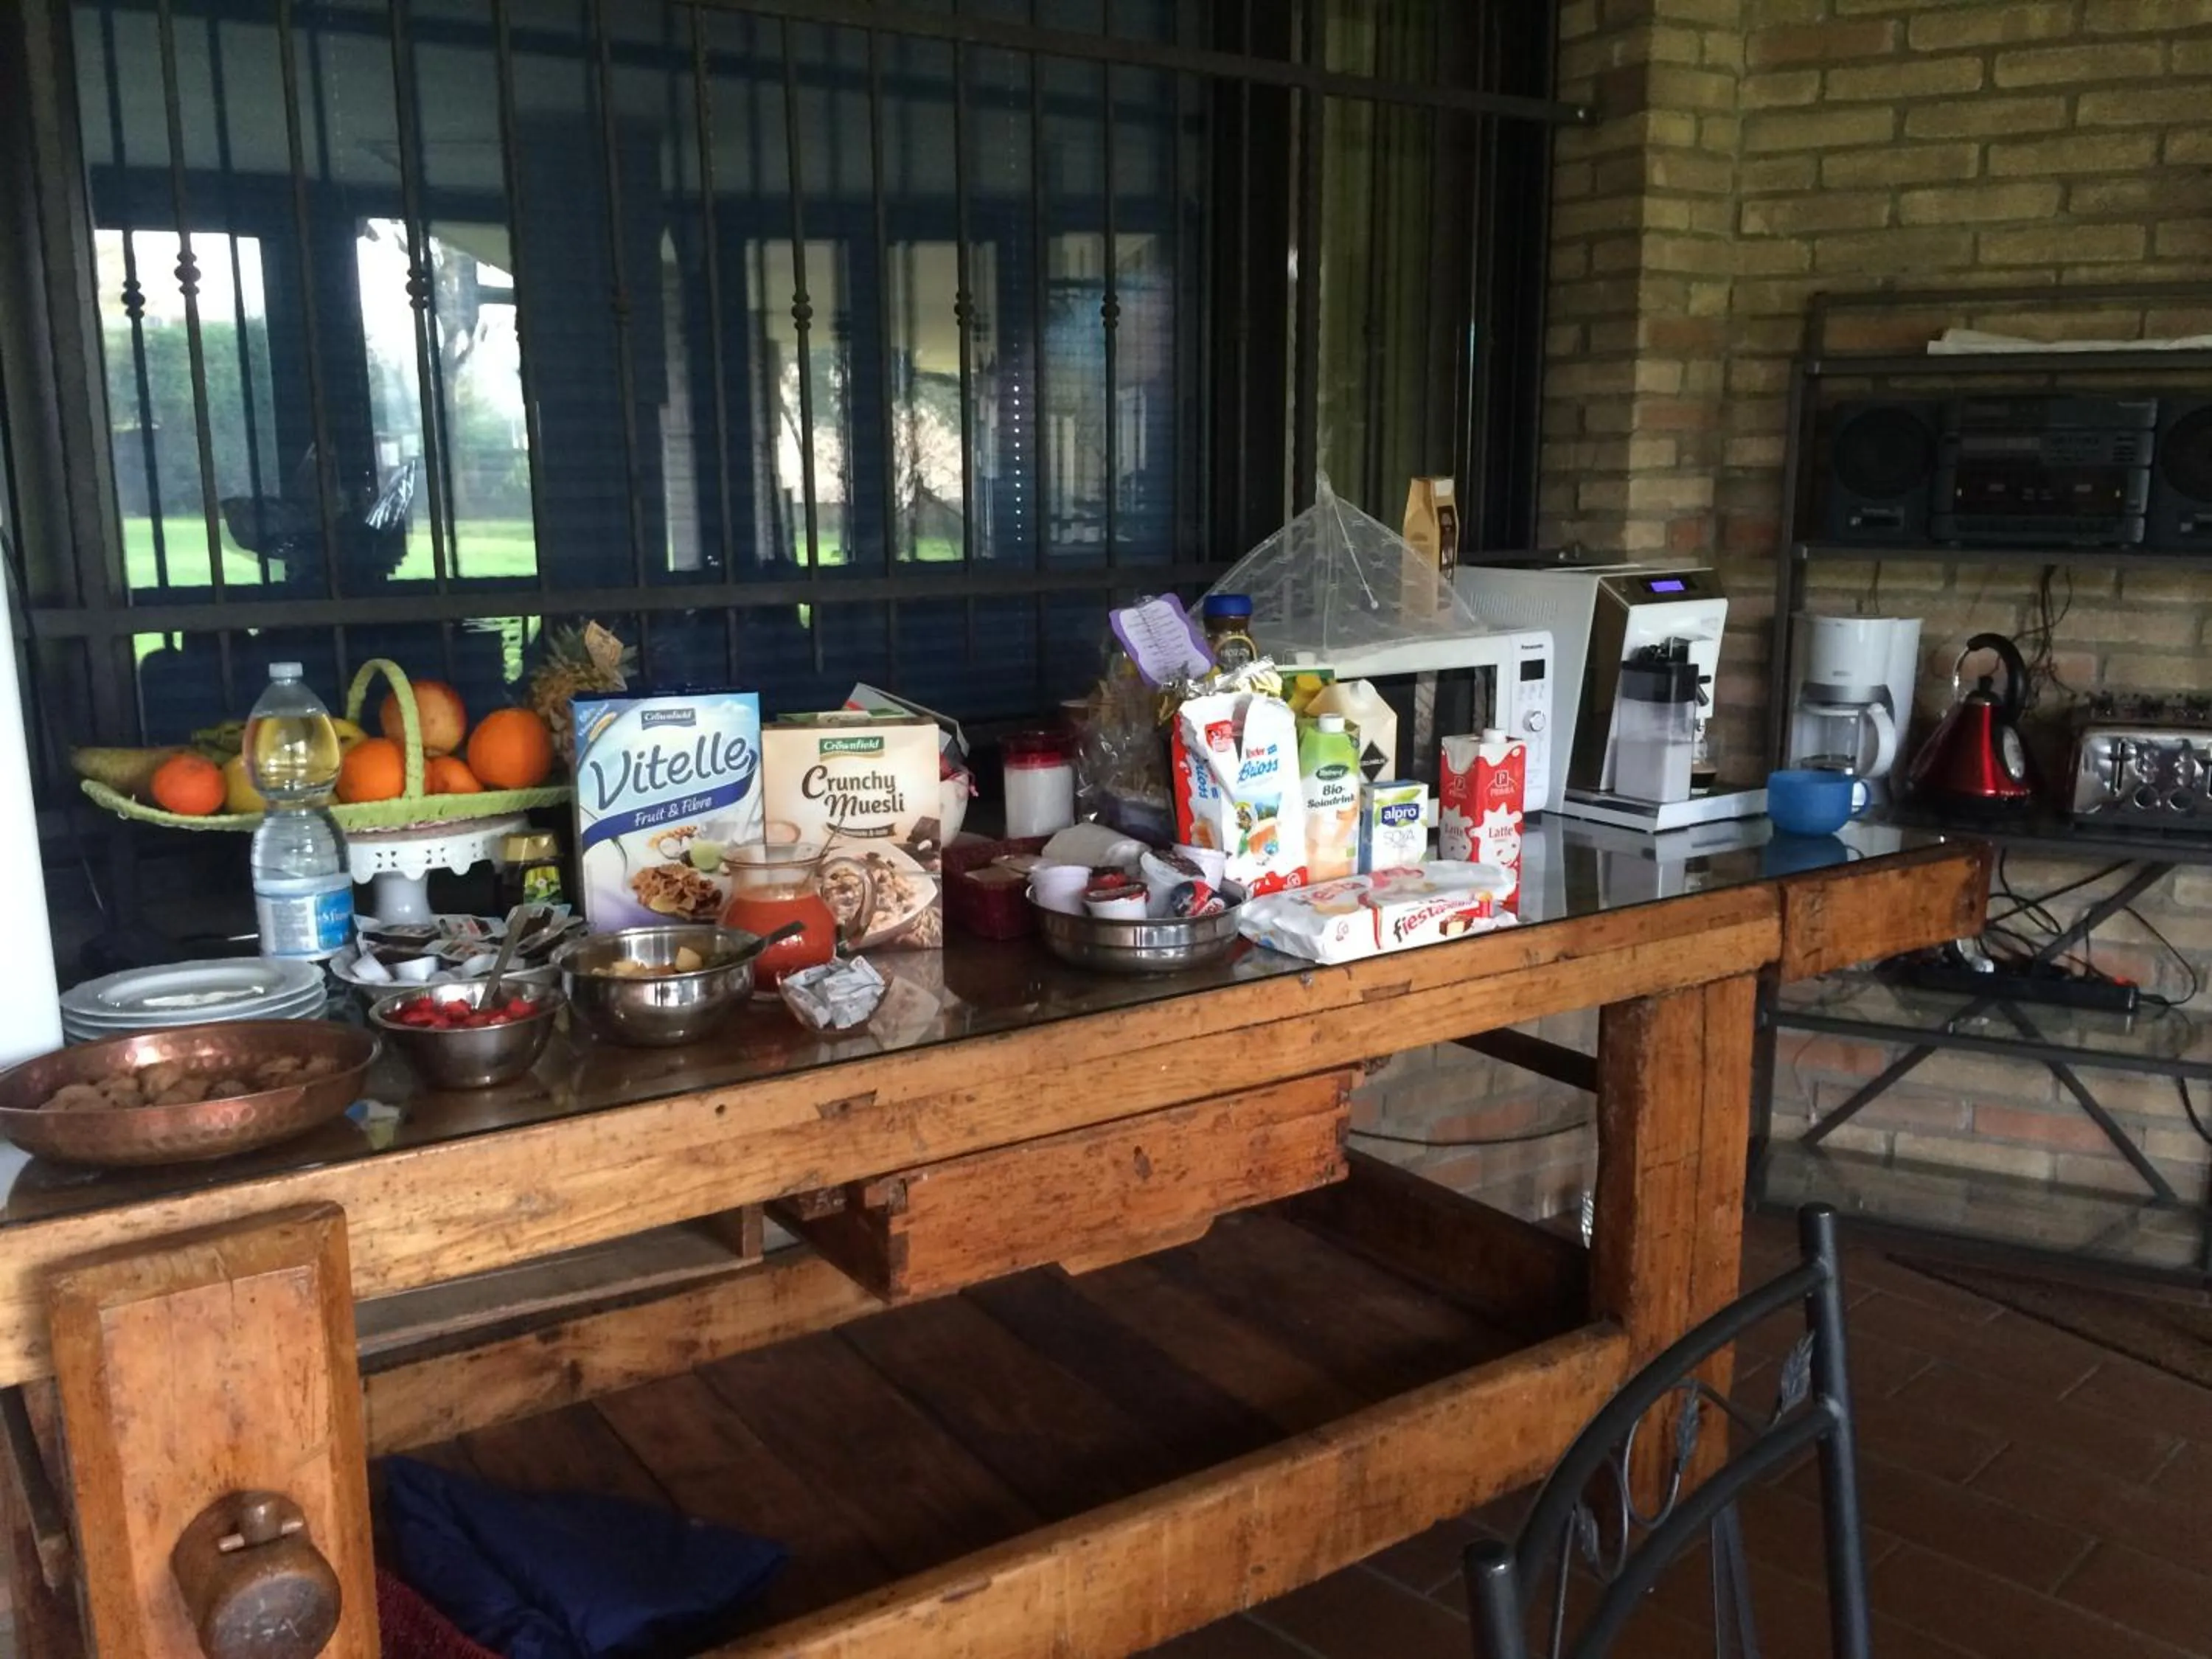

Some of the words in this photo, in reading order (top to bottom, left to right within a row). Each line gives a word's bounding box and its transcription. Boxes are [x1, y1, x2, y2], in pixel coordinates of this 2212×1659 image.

[590, 731, 750, 810] Vitelle
[801, 765, 897, 799] Crunchy
[1322, 784, 1346, 796] Bio-
[635, 810, 665, 827] Fruit
[668, 804, 680, 818] &
[682, 797, 712, 813] Fibre
[824, 793, 905, 817] Muesli
[1383, 807, 1417, 822] alpro
[1489, 827, 1514, 838] Latte
[1393, 904, 1447, 943] fiesta
